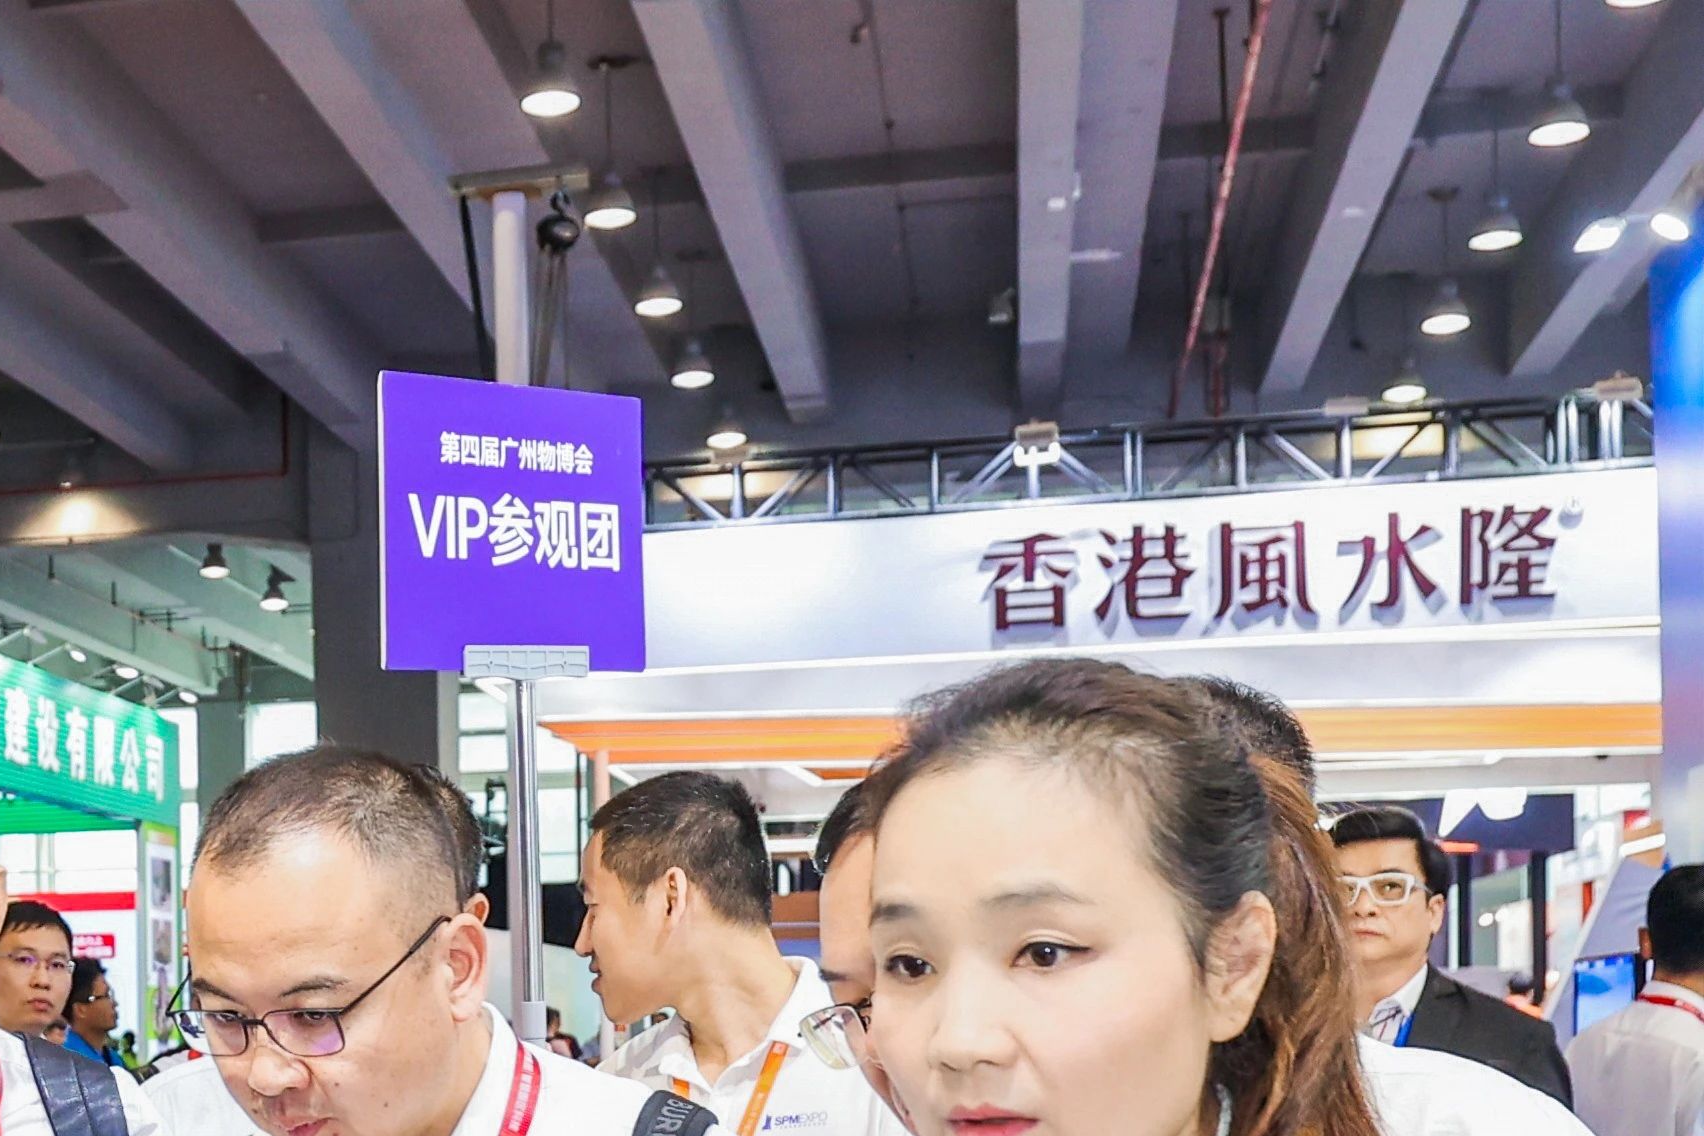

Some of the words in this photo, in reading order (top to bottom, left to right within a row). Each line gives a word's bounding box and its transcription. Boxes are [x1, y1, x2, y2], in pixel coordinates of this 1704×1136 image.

[440, 431, 594, 475] 第四届广州物博会
[408, 492, 621, 573] VIP参观团
[982, 505, 1558, 632] 香港風水隆
[774, 1111, 828, 1126] SPMEXPO
